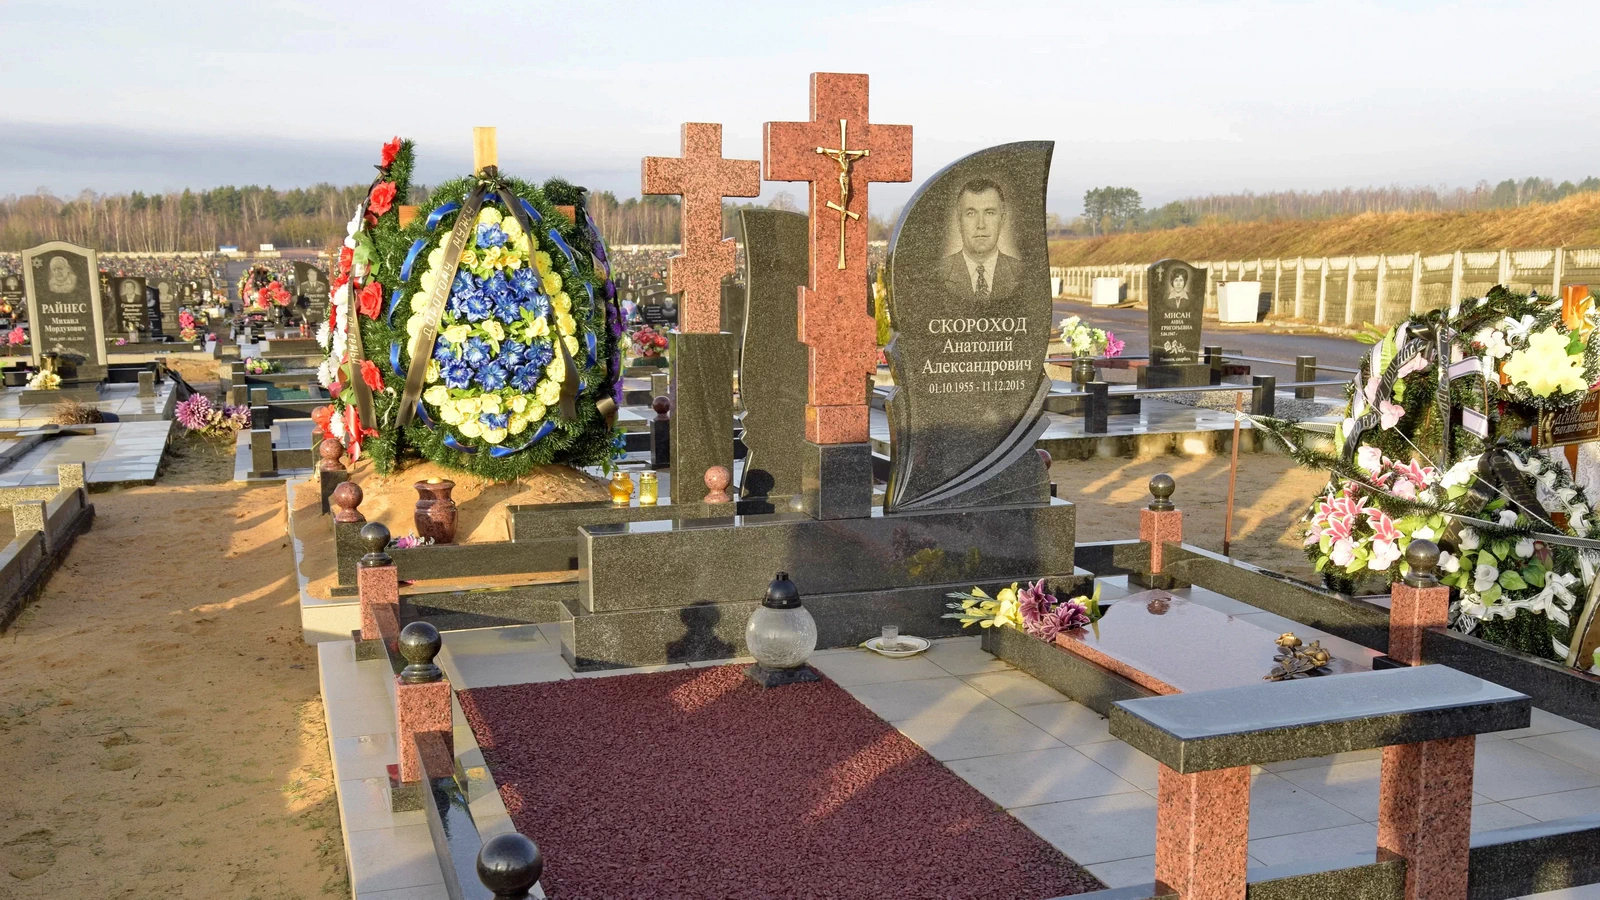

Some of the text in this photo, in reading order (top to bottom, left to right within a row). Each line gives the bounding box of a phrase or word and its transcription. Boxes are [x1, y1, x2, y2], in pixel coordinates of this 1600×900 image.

[422, 205, 475, 341] ДОРОГОМУ МУЖУ
[41, 301, 87, 314] РАЙНЕС
[928, 317, 1028, 335] СКОРОХОД
[942, 336, 1014, 354] Анатолий
[921, 358, 1033, 377] Александрович
[928, 381, 975, 395] 01.10.1955
[982, 379, 1027, 393] 11.12.2015
